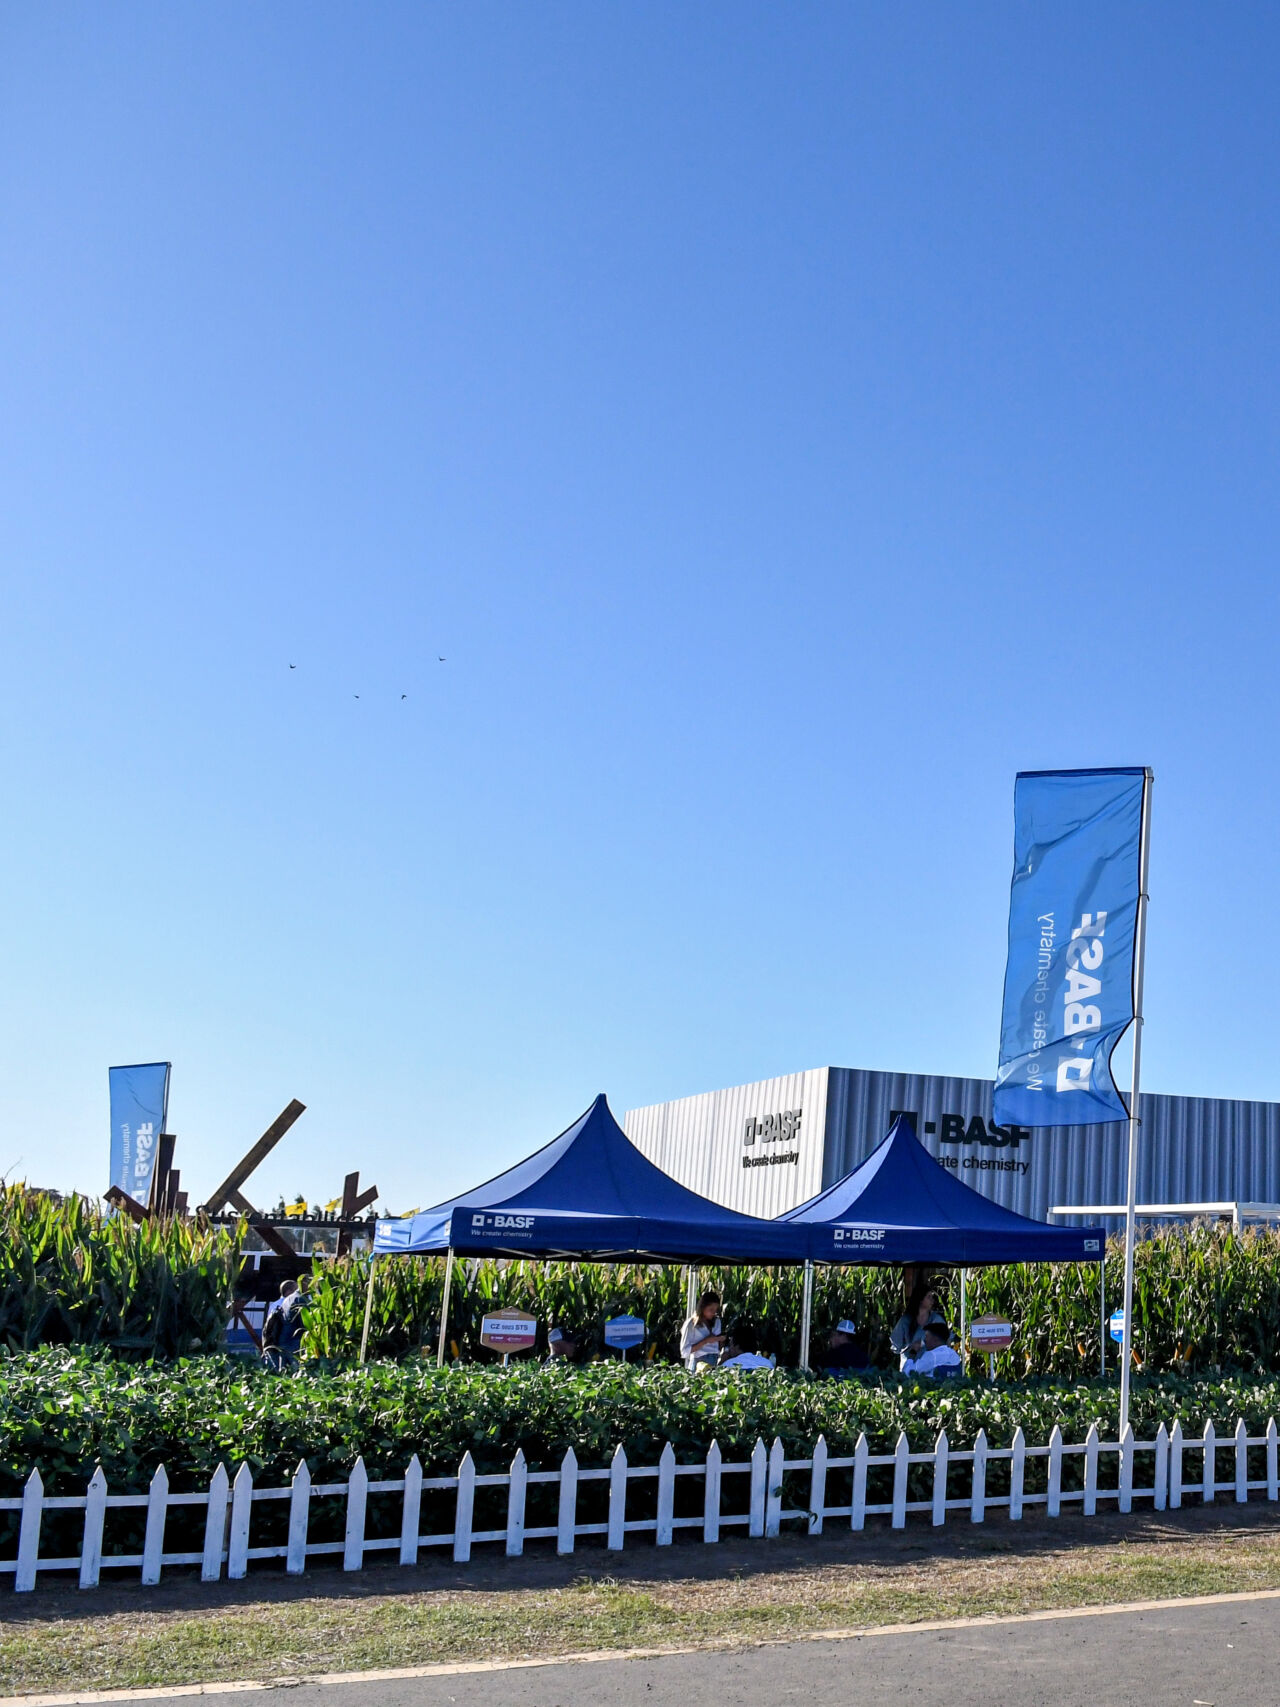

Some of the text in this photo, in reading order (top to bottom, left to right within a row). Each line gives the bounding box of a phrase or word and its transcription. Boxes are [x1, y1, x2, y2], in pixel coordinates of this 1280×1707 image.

[761, 1108, 802, 1143] BASF
[940, 1114, 1030, 1148] BASF
[962, 1156, 1030, 1175] chemistry
[494, 1215, 536, 1229] BASF
[502, 1231, 533, 1239] chemistry
[852, 1229, 886, 1241] BASF
[860, 1243, 885, 1251] chemistry
